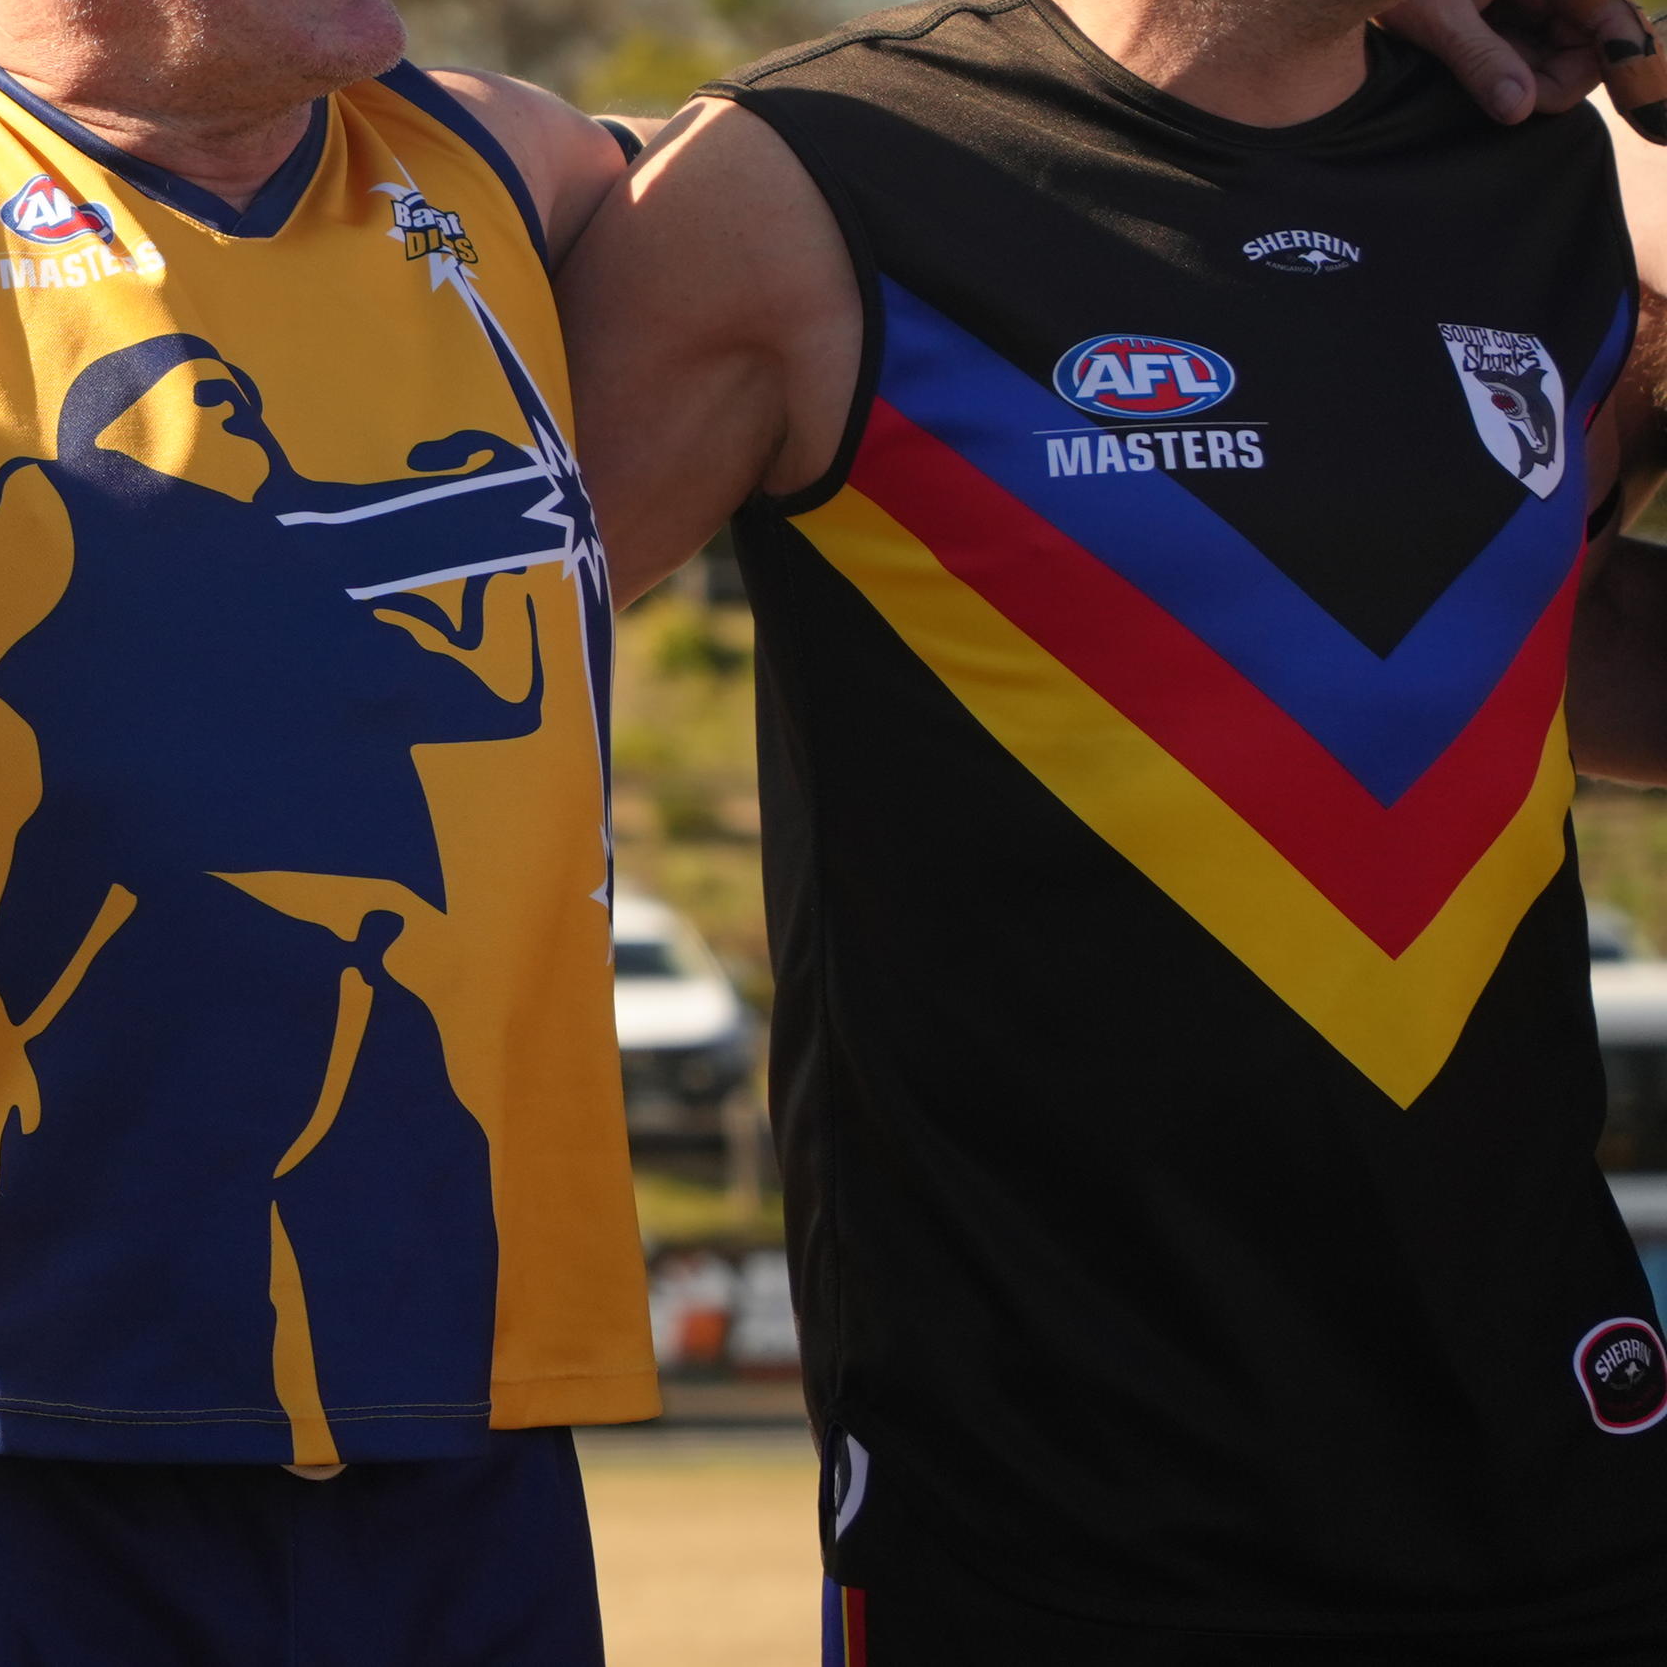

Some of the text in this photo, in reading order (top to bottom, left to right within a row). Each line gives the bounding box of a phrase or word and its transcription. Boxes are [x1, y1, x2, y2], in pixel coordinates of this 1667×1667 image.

[1242, 229, 1361, 262] SHERRIN
[1440, 324, 1540, 351] SOUTH COAST
[1076, 353, 1222, 400] AFL
[1047, 430, 1265, 479] MASTERS
[1594, 1338, 1652, 1383] SHERRIN
